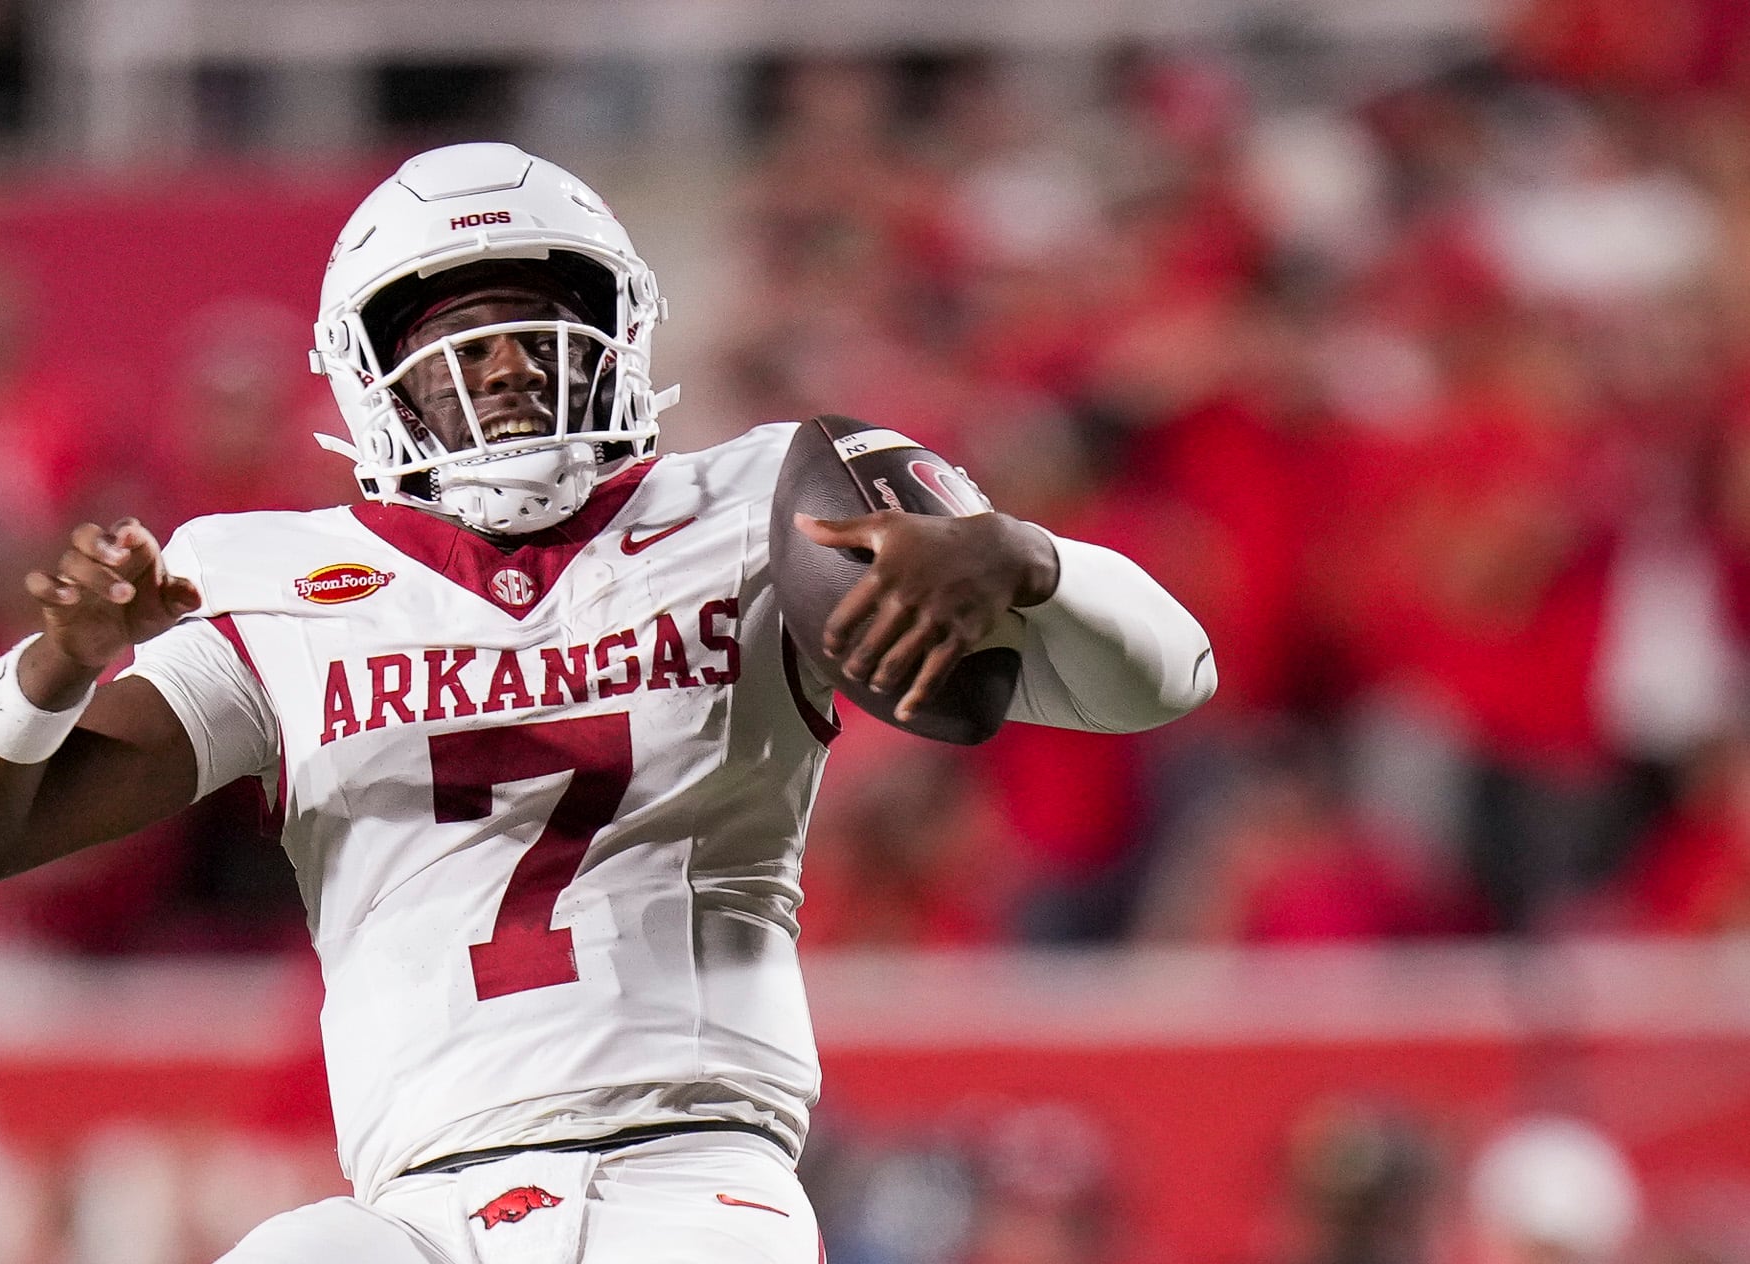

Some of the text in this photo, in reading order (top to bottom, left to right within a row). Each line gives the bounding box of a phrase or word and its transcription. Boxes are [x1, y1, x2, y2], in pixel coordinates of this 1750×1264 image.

[450, 211, 511, 230] HOGS
[492, 569, 535, 605] SEC
[320, 597, 741, 746] ARKANSAS
[428, 711, 634, 1001] 7
